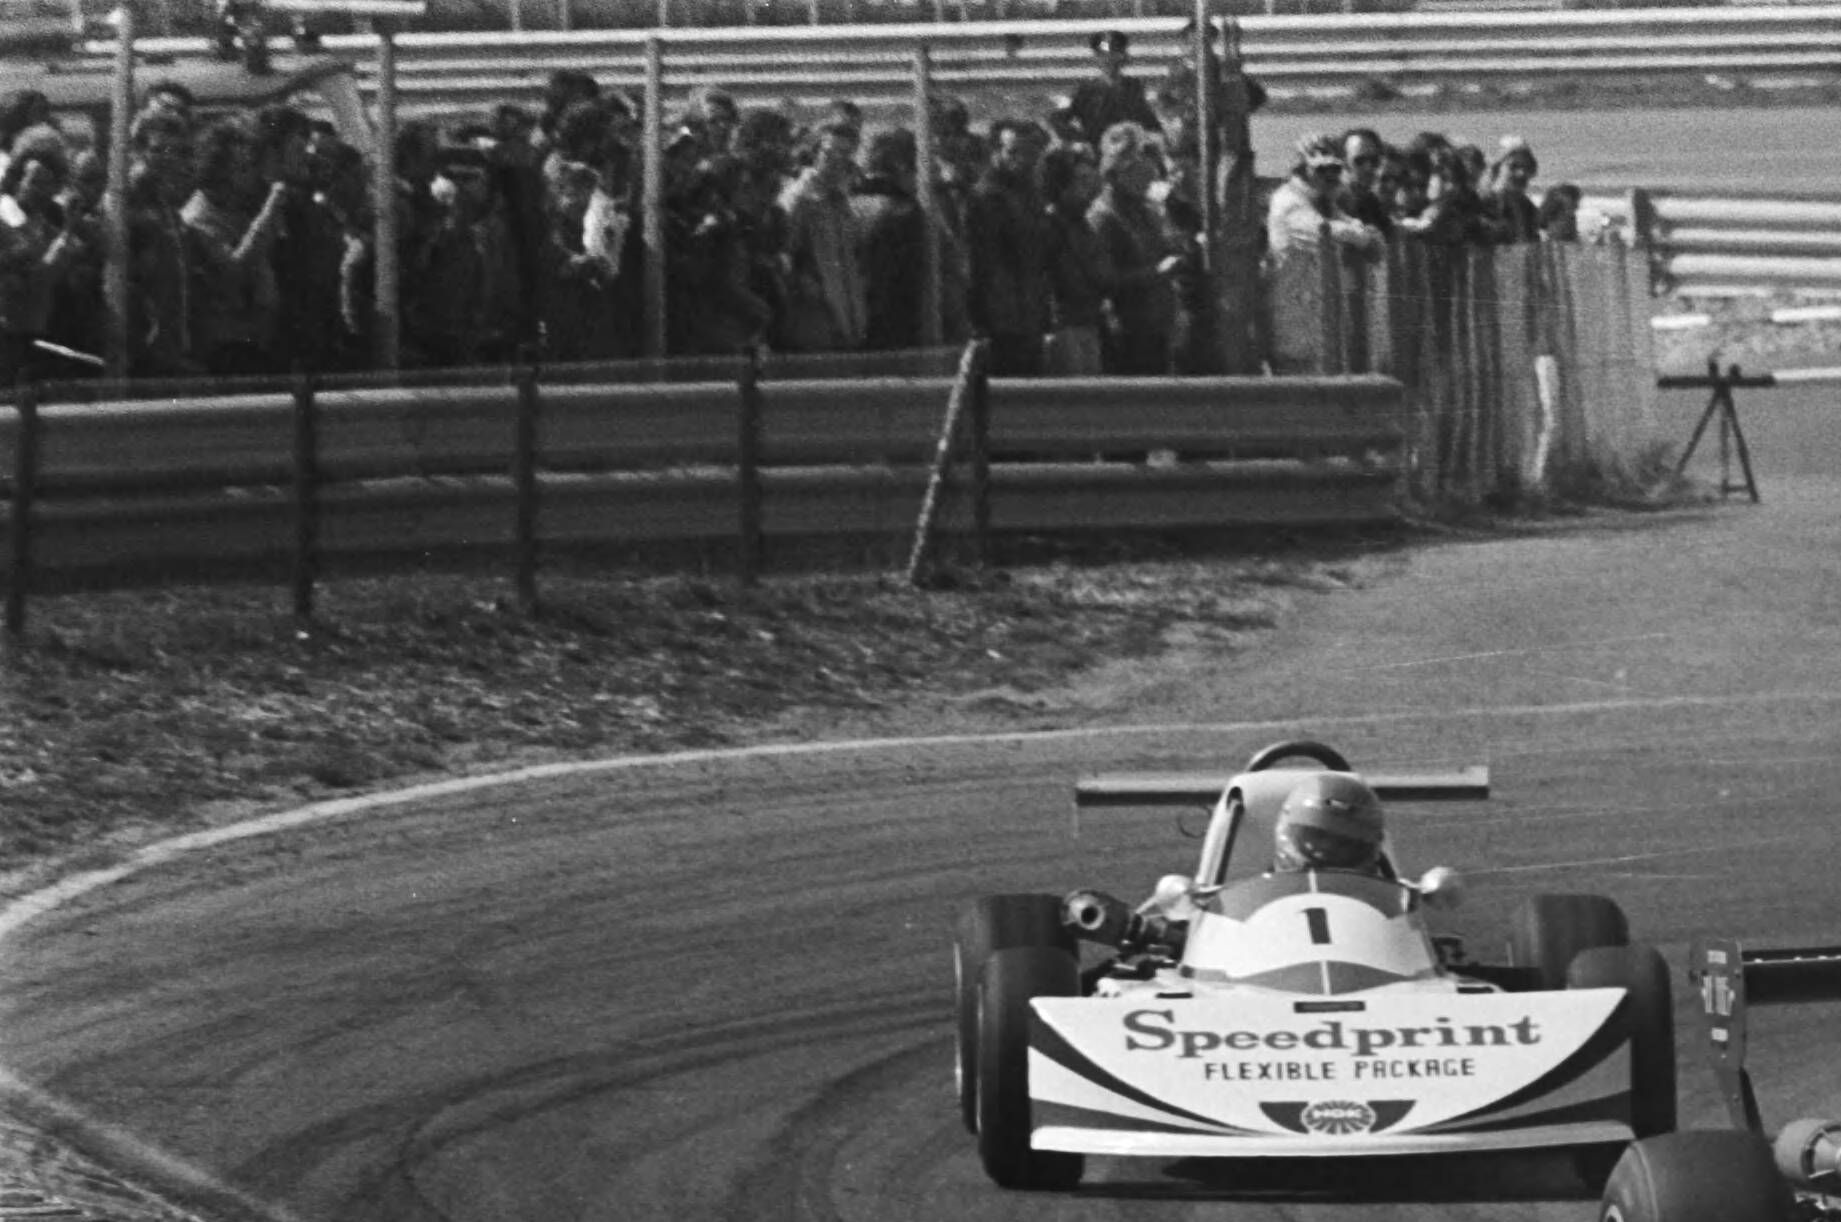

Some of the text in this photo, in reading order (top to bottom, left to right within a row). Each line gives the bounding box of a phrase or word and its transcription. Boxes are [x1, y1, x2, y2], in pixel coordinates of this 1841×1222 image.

[1300, 907, 1333, 944] 1
[1123, 1008, 1542, 1058] Speedprint
[1204, 1058, 1476, 1081] FLEXIBLE PACKAGE
